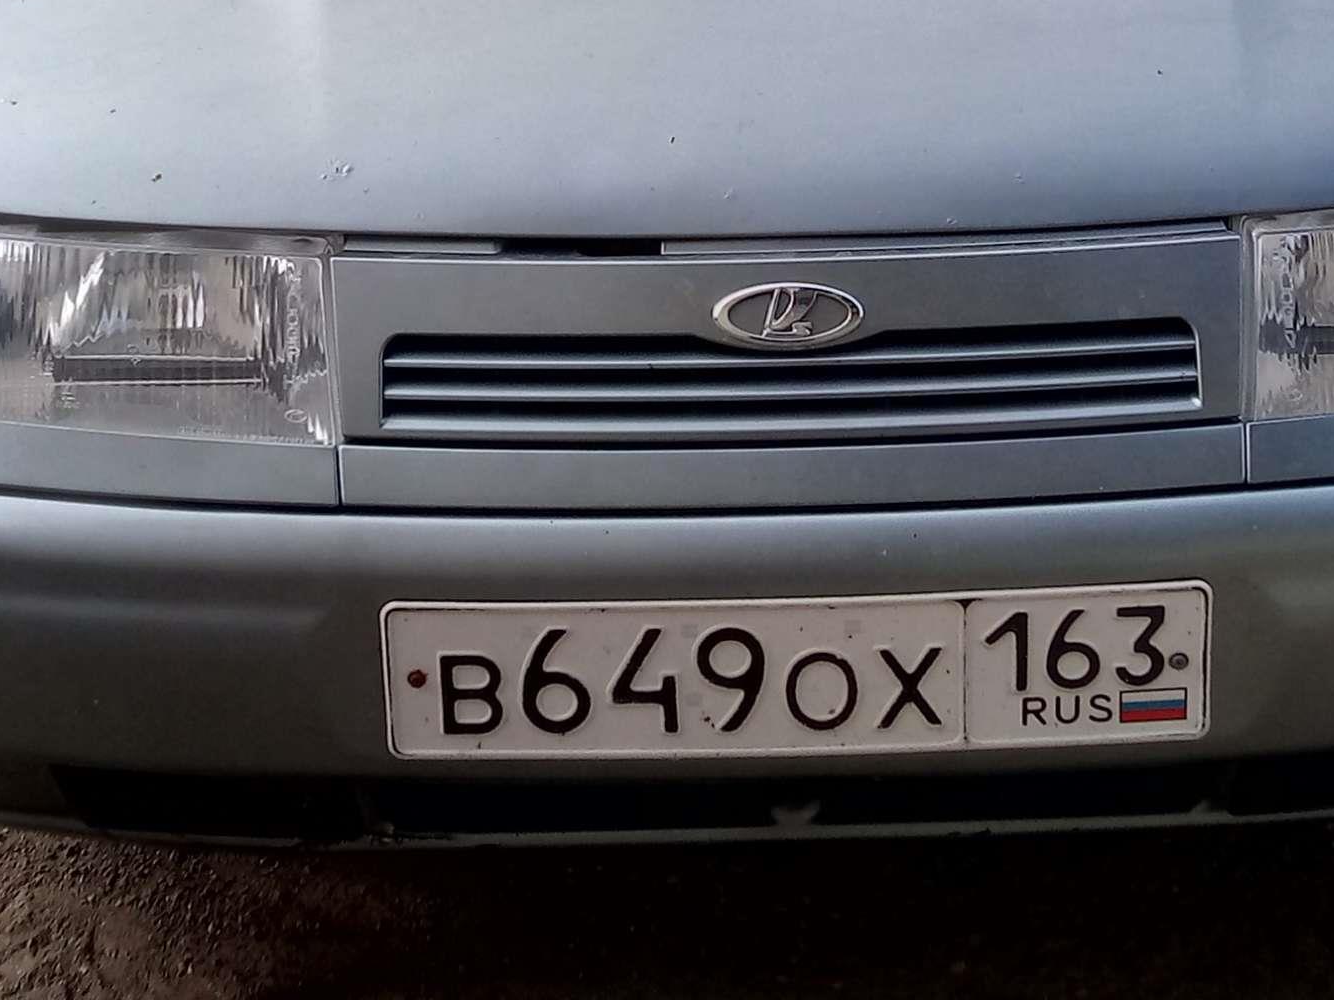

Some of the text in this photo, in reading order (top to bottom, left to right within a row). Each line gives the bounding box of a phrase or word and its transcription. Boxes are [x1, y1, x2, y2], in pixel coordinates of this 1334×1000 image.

[438, 604, 1168, 736] В649ОХ 163
[1021, 692, 1113, 727] RUS
